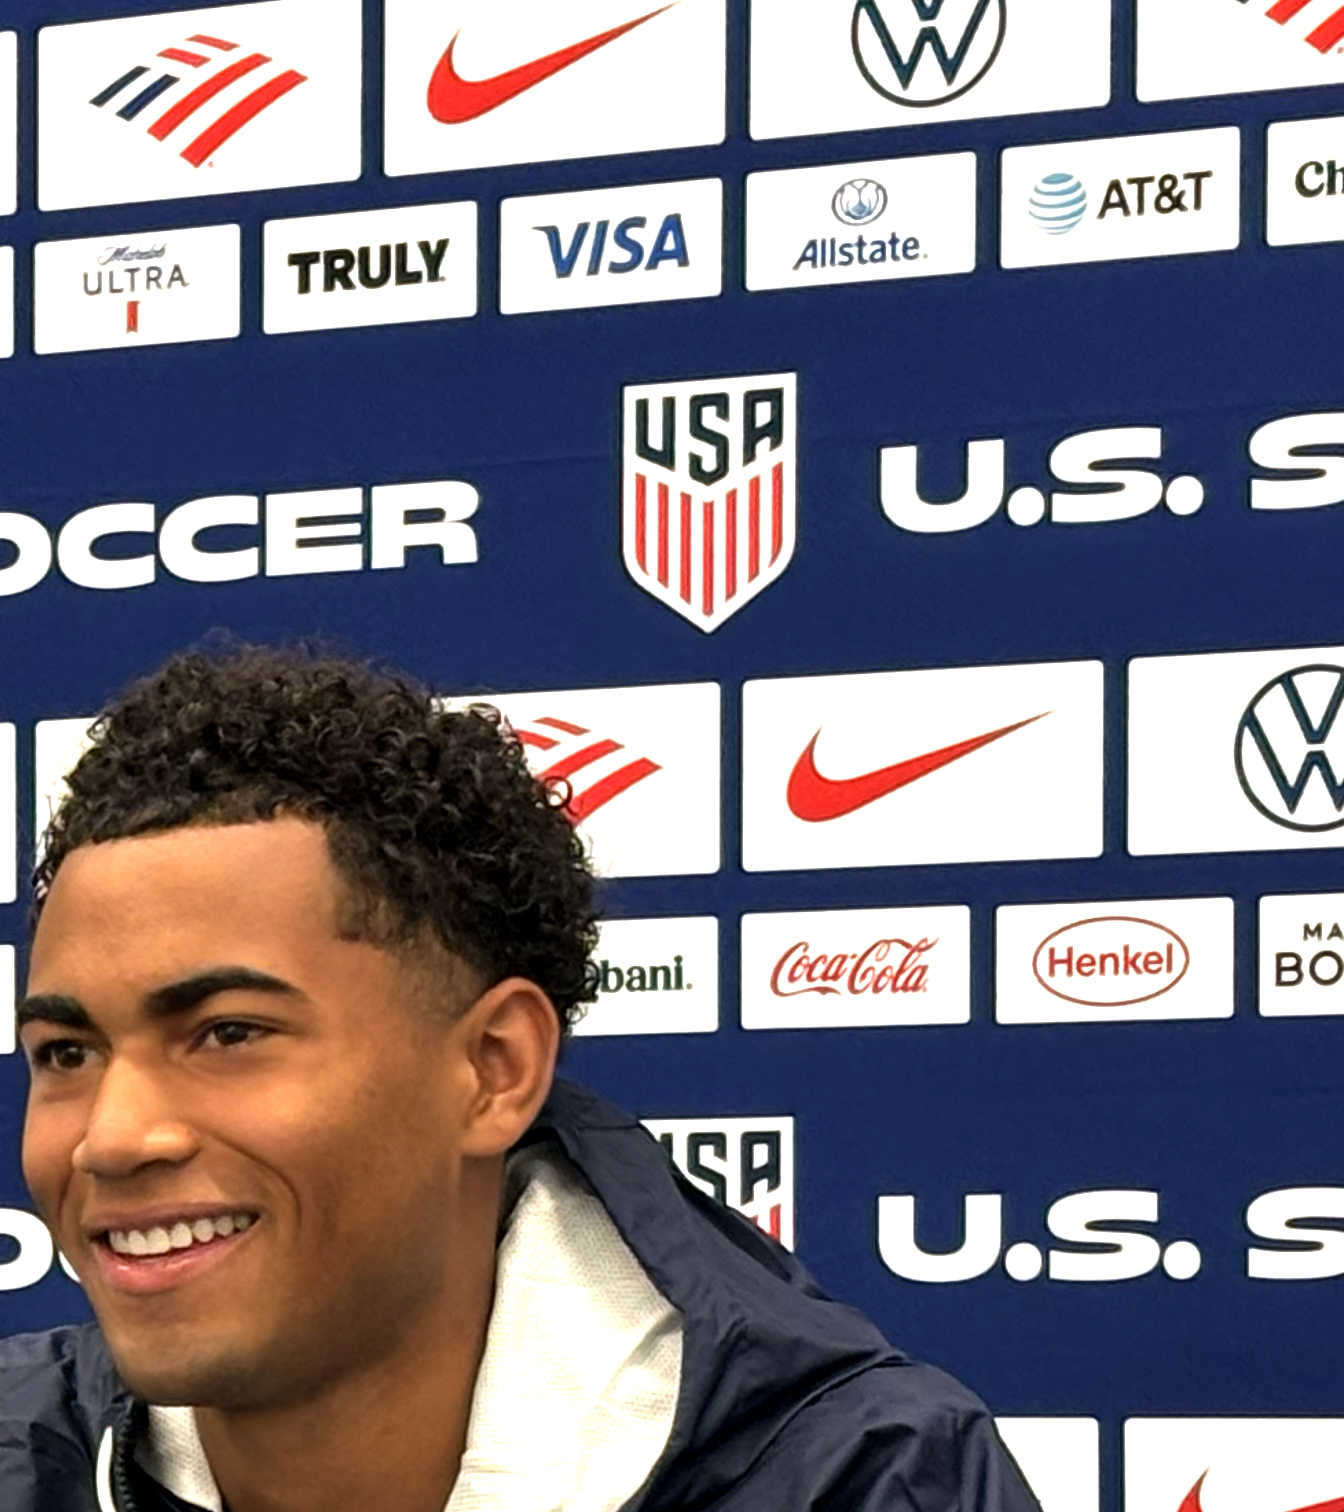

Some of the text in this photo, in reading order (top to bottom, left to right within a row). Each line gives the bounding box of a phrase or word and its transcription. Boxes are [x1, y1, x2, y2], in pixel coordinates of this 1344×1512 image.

[1097, 170, 1213, 219] AT&T
[288, 238, 450, 295] TRULY
[532, 213, 689, 278] VISA
[84, 264, 188, 295] ULTRA
[636, 388, 783, 485] USA
[881, 428, 1203, 532] U.S.
[600, 954, 684, 993] bani
[1048, 943, 1173, 978] Henkel
[660, 1129, 781, 1207] SA
[879, 1191, 1200, 1282] U.S.
